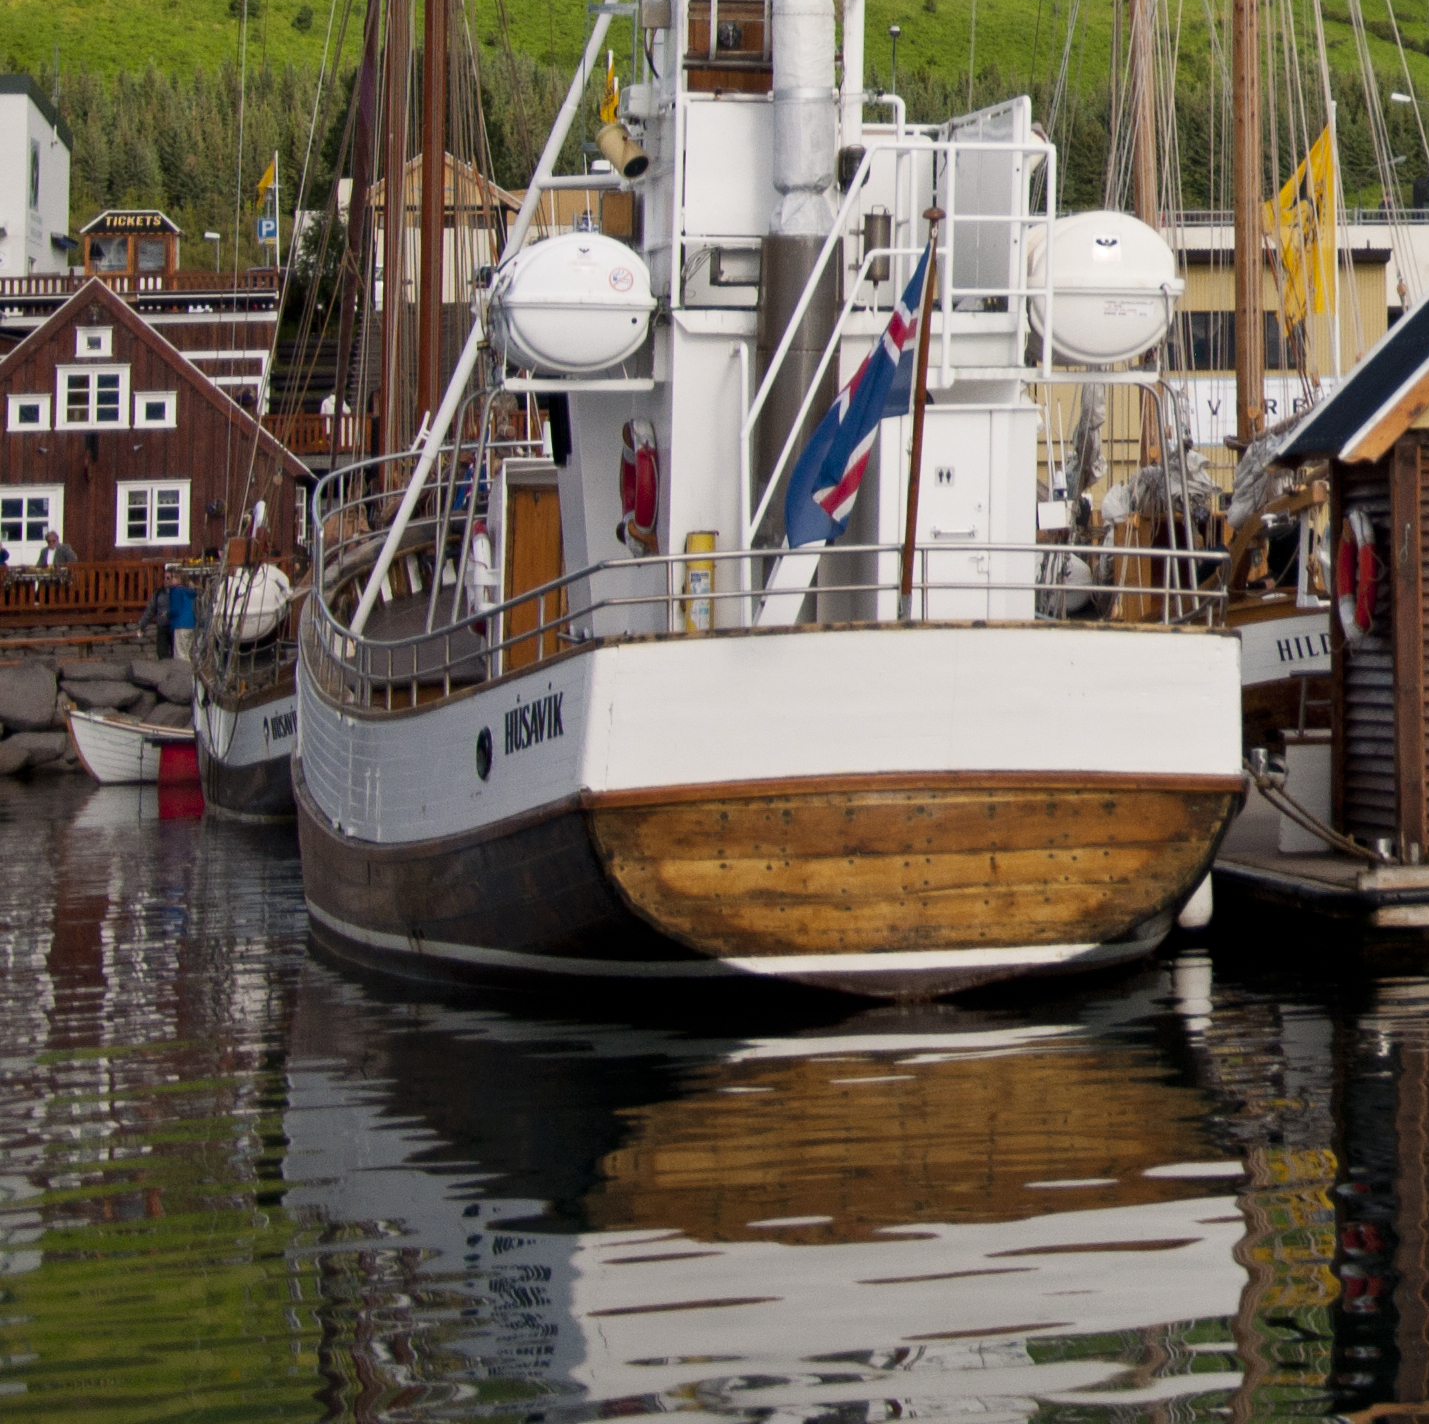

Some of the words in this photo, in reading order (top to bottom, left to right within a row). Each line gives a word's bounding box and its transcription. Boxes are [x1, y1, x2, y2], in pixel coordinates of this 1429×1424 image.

[105, 215, 162, 226] TICKETS
[262, 220, 274, 234] P
[271, 704, 298, 740] HÚSAVÍ
[505, 682, 564, 755] HÚSAVÍK
